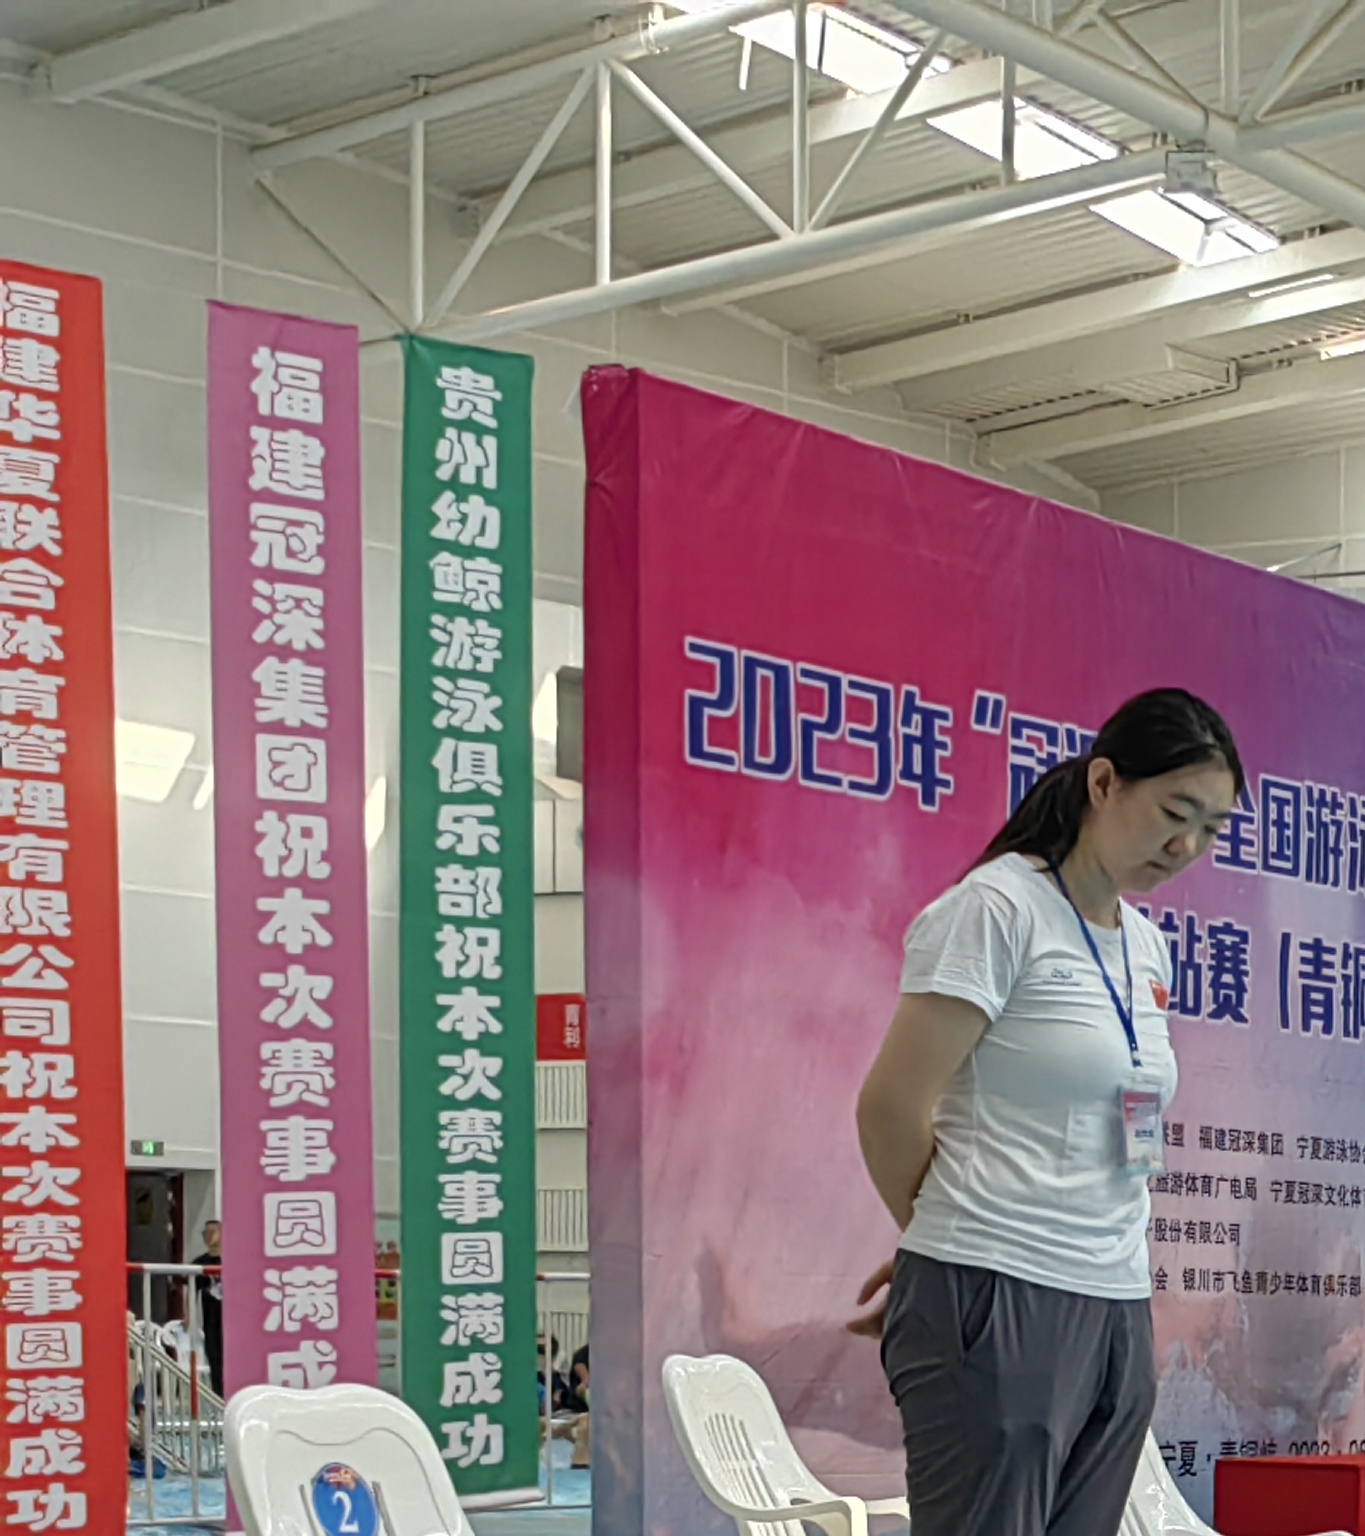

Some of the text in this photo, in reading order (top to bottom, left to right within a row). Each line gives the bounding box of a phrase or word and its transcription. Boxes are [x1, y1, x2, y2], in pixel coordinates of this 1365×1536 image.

[427, 364, 505, 1469] 贵州幼鲸游泳俱乐部祝本次赛事圆满成功
[331, 1490, 360, 1534] 2
